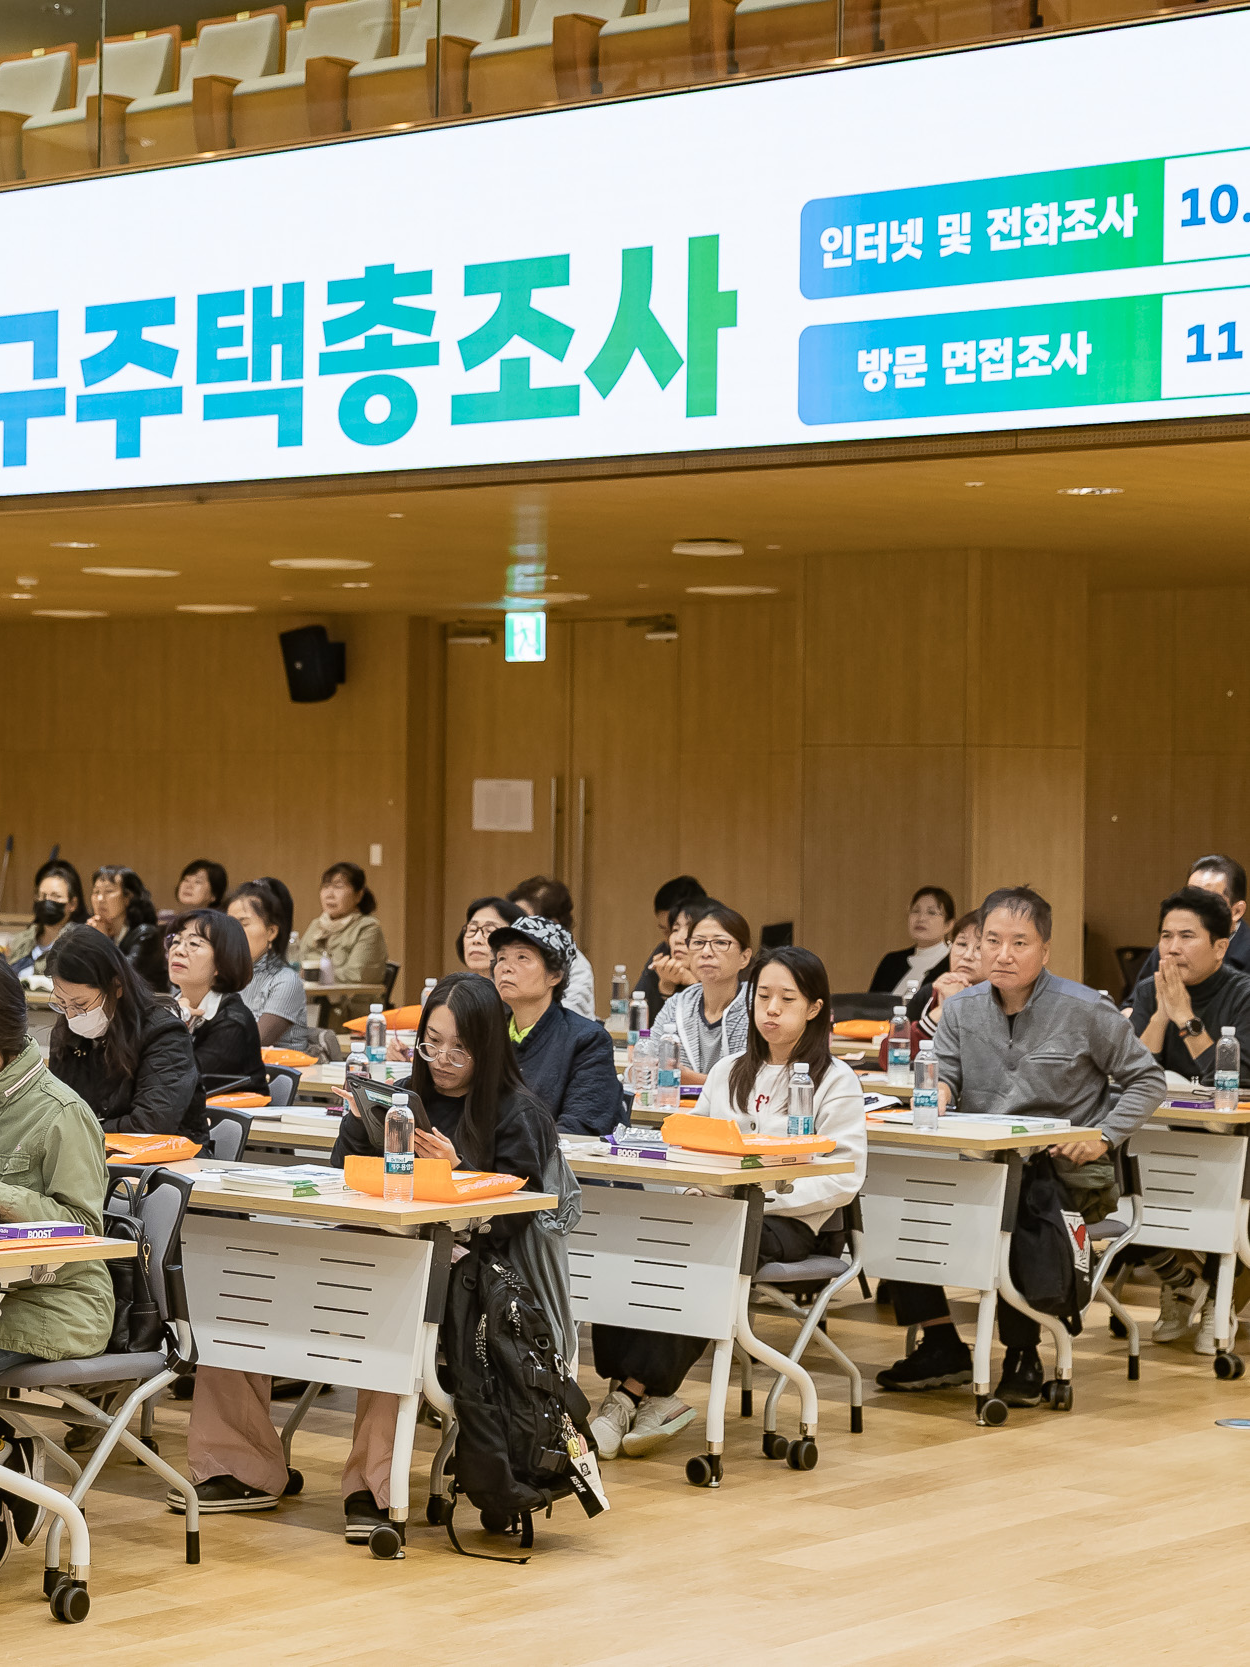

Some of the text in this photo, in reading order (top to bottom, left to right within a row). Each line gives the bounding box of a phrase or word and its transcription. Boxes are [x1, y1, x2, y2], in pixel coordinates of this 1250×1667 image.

[819, 192, 1138, 269] 인터넷 및 전화조사
[857, 330, 1092, 393] 방문 면접조사
[1185, 321, 1244, 364] 11
[27, 1229, 52, 1239] BOOST
